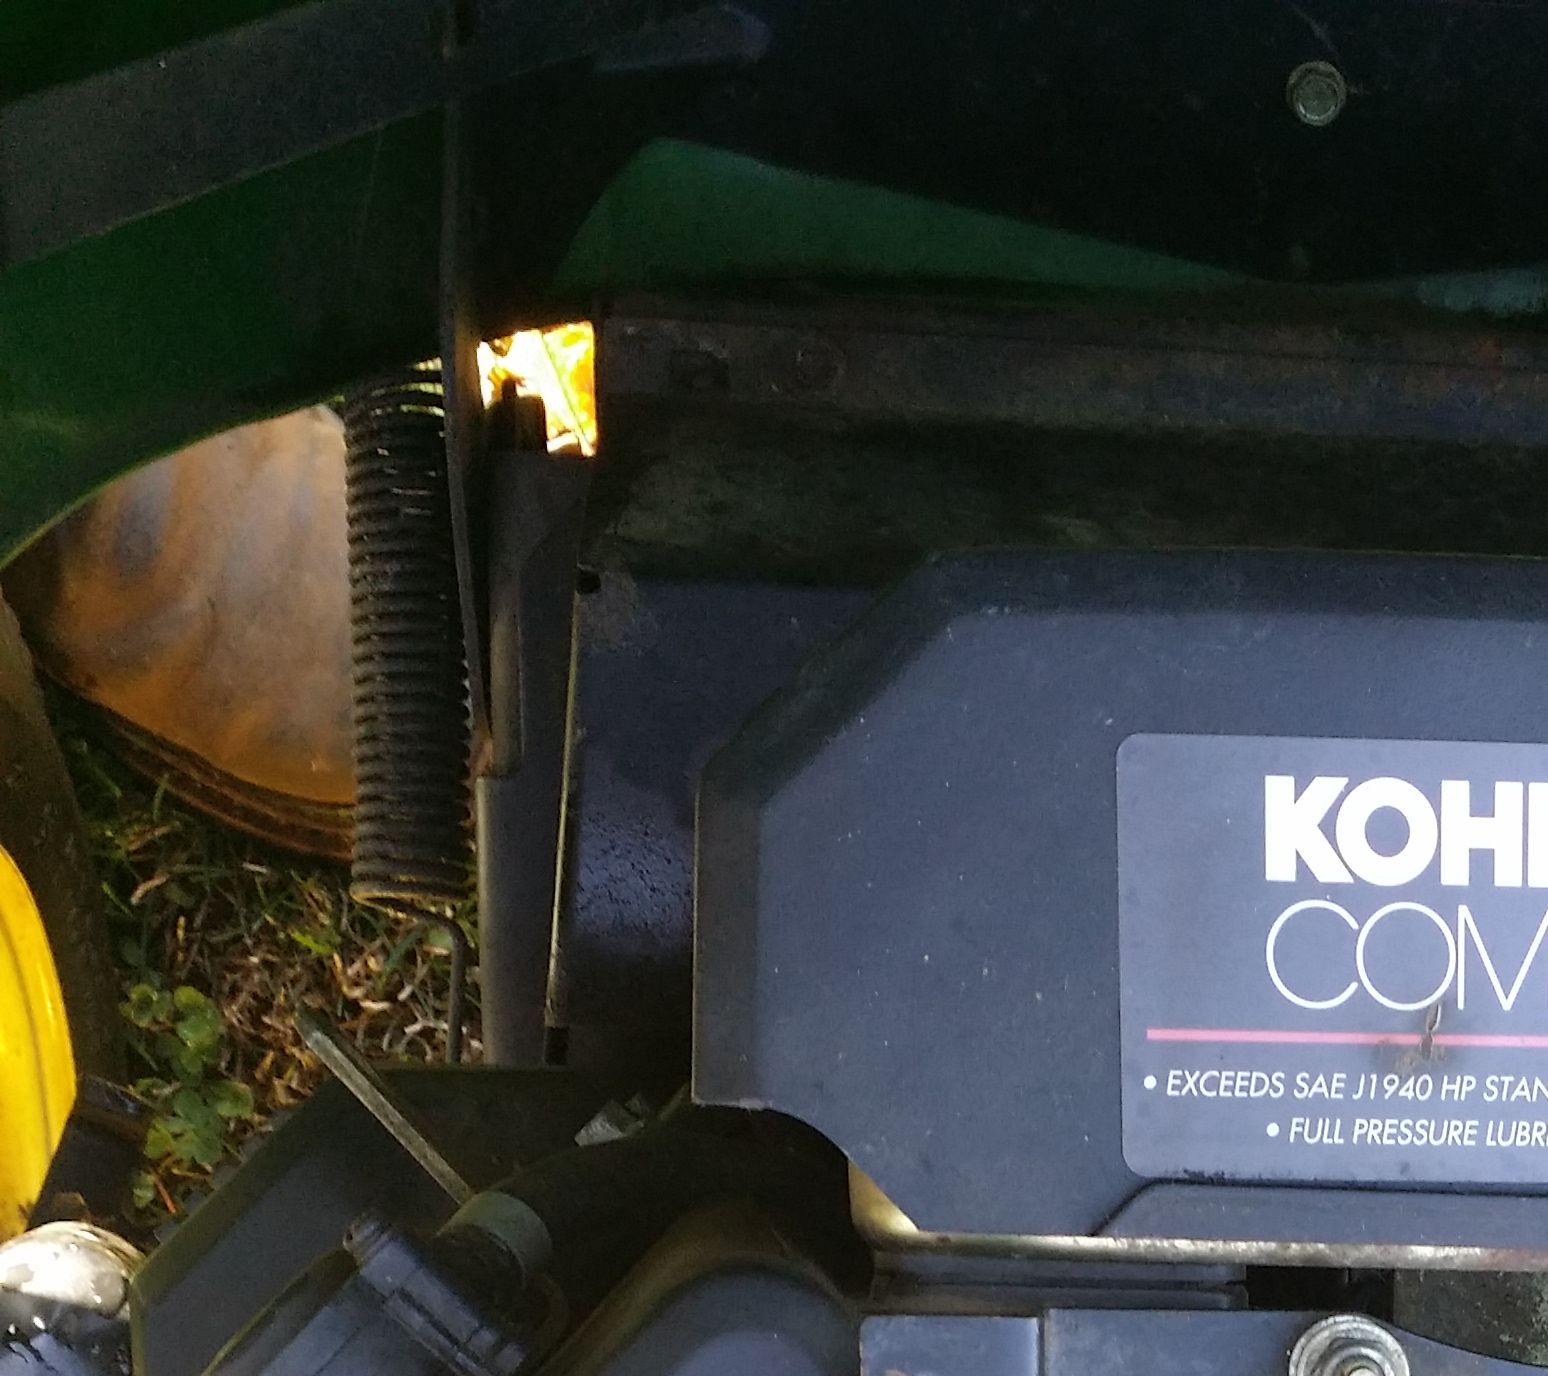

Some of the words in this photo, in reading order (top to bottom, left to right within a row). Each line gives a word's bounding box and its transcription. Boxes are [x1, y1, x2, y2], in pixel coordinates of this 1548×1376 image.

[1166, 1070, 1286, 1098] EXCEEDS
[1293, 1072, 1347, 1100] SAE
[1352, 1073, 1433, 1101] J1940
[1440, 1075, 1479, 1101] HP
[1288, 1117, 1346, 1144] FULL
[1351, 1119, 1479, 1147] PRESSURE
